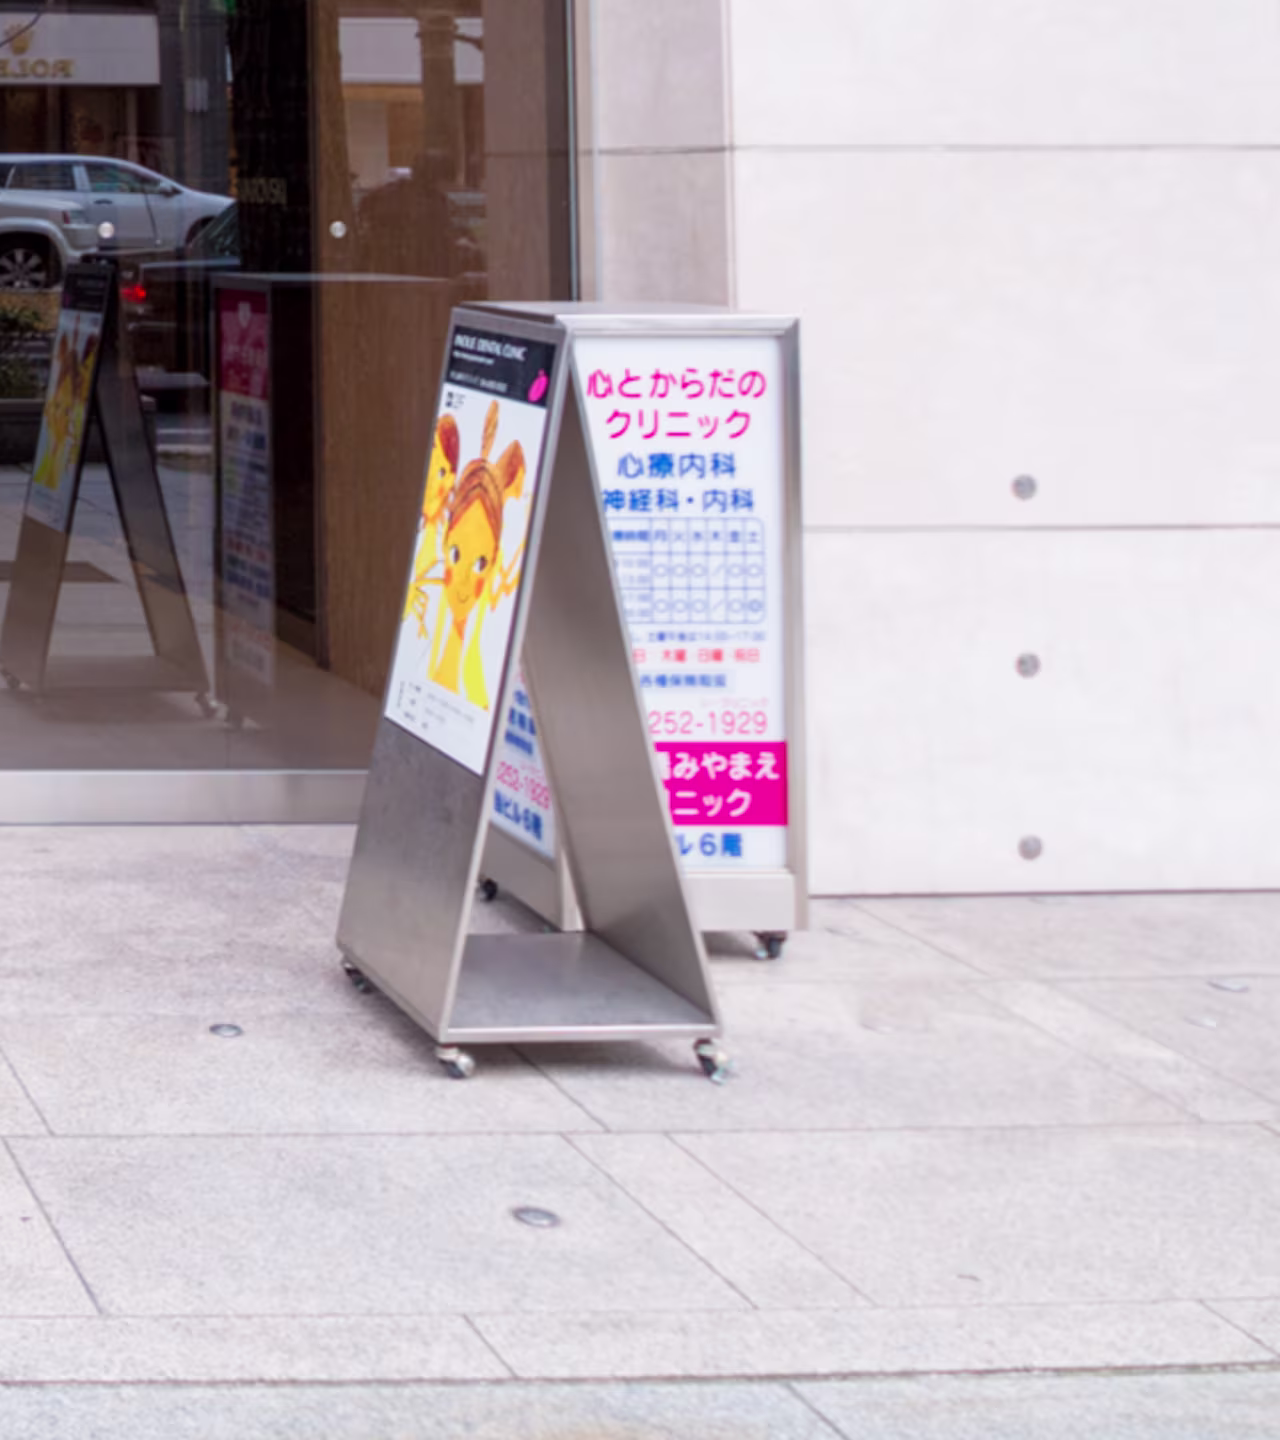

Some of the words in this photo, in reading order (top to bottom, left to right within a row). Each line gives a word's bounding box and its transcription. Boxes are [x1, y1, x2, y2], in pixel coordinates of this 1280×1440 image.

[587, 367, 767, 399] 心とからだの
[606, 409, 751, 439] クリニック
[617, 452, 736, 479] 心療内科
[602, 488, 754, 513] 神経科・内科
[648, 710, 769, 735] 252-1929
[669, 788, 752, 818] ニック
